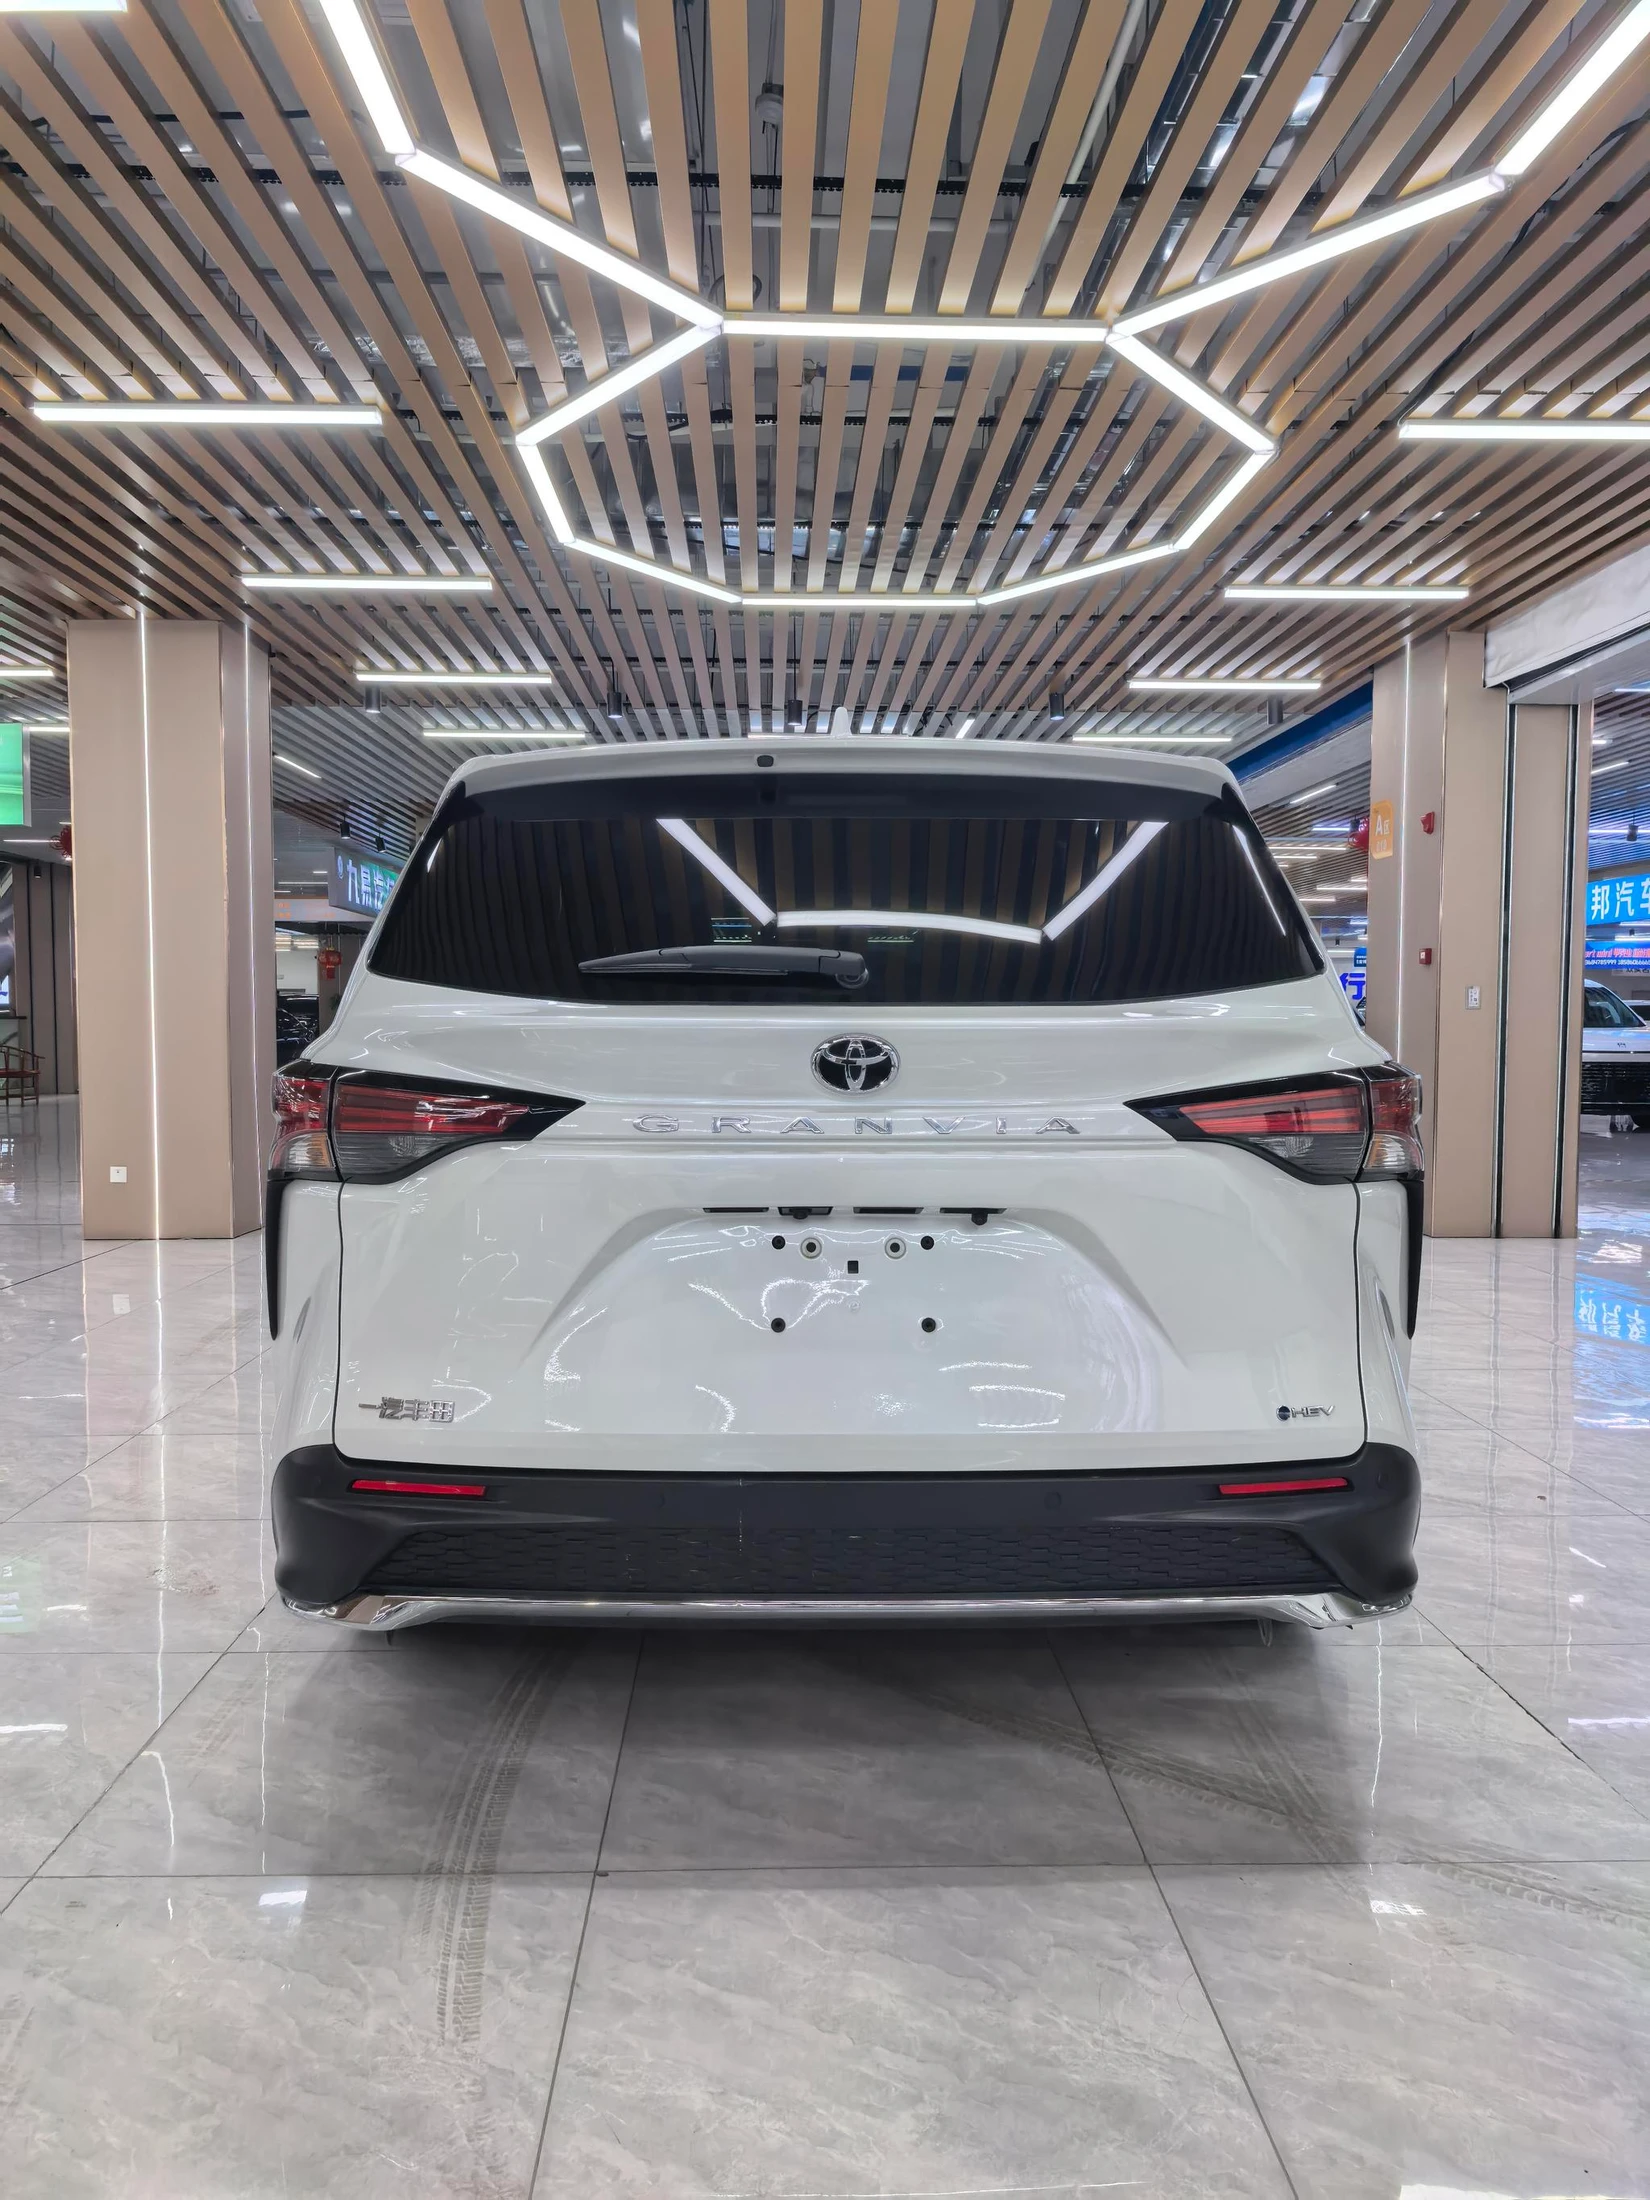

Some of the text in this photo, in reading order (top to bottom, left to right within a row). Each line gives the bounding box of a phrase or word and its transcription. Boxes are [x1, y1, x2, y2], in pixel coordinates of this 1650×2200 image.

[632, 1115, 1080, 1134] GRANVIA
[359, 1397, 455, 1423] 一汽丰田
[1291, 1405, 1335, 1418] HEV
